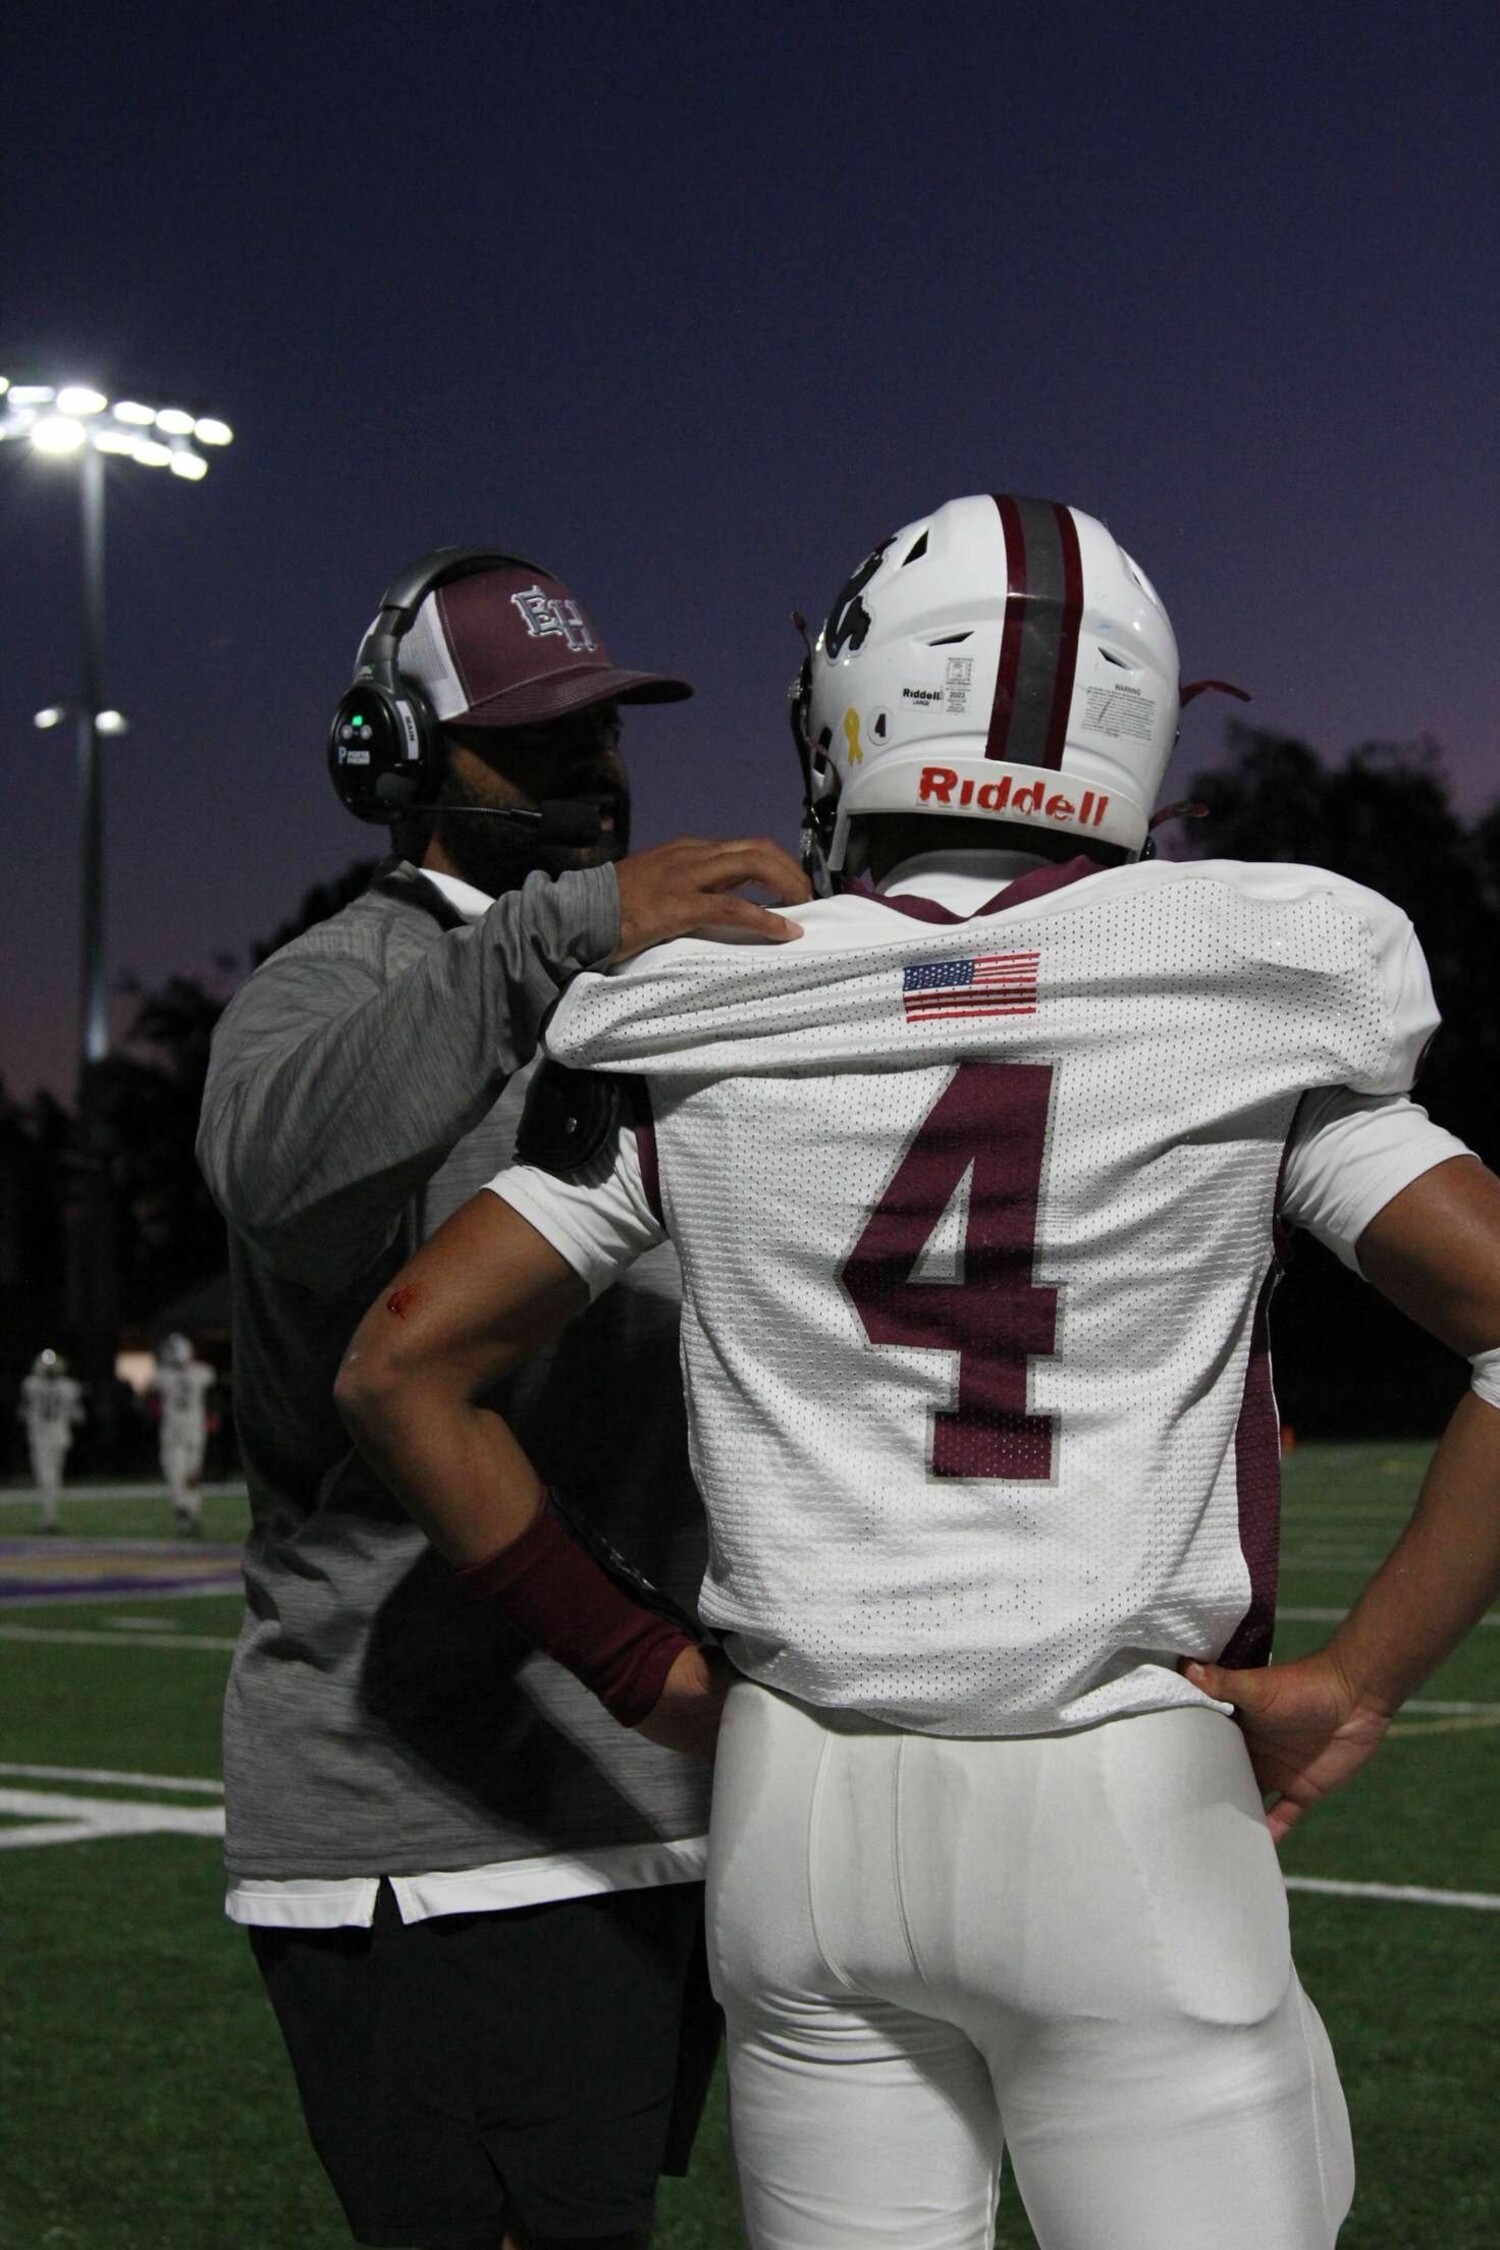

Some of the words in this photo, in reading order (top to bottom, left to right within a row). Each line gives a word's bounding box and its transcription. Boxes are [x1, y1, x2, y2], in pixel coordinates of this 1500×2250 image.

[902, 687, 941, 701] Riddell
[918, 766, 1109, 827] Riddell
[833, 1057, 1068, 1487] 4
